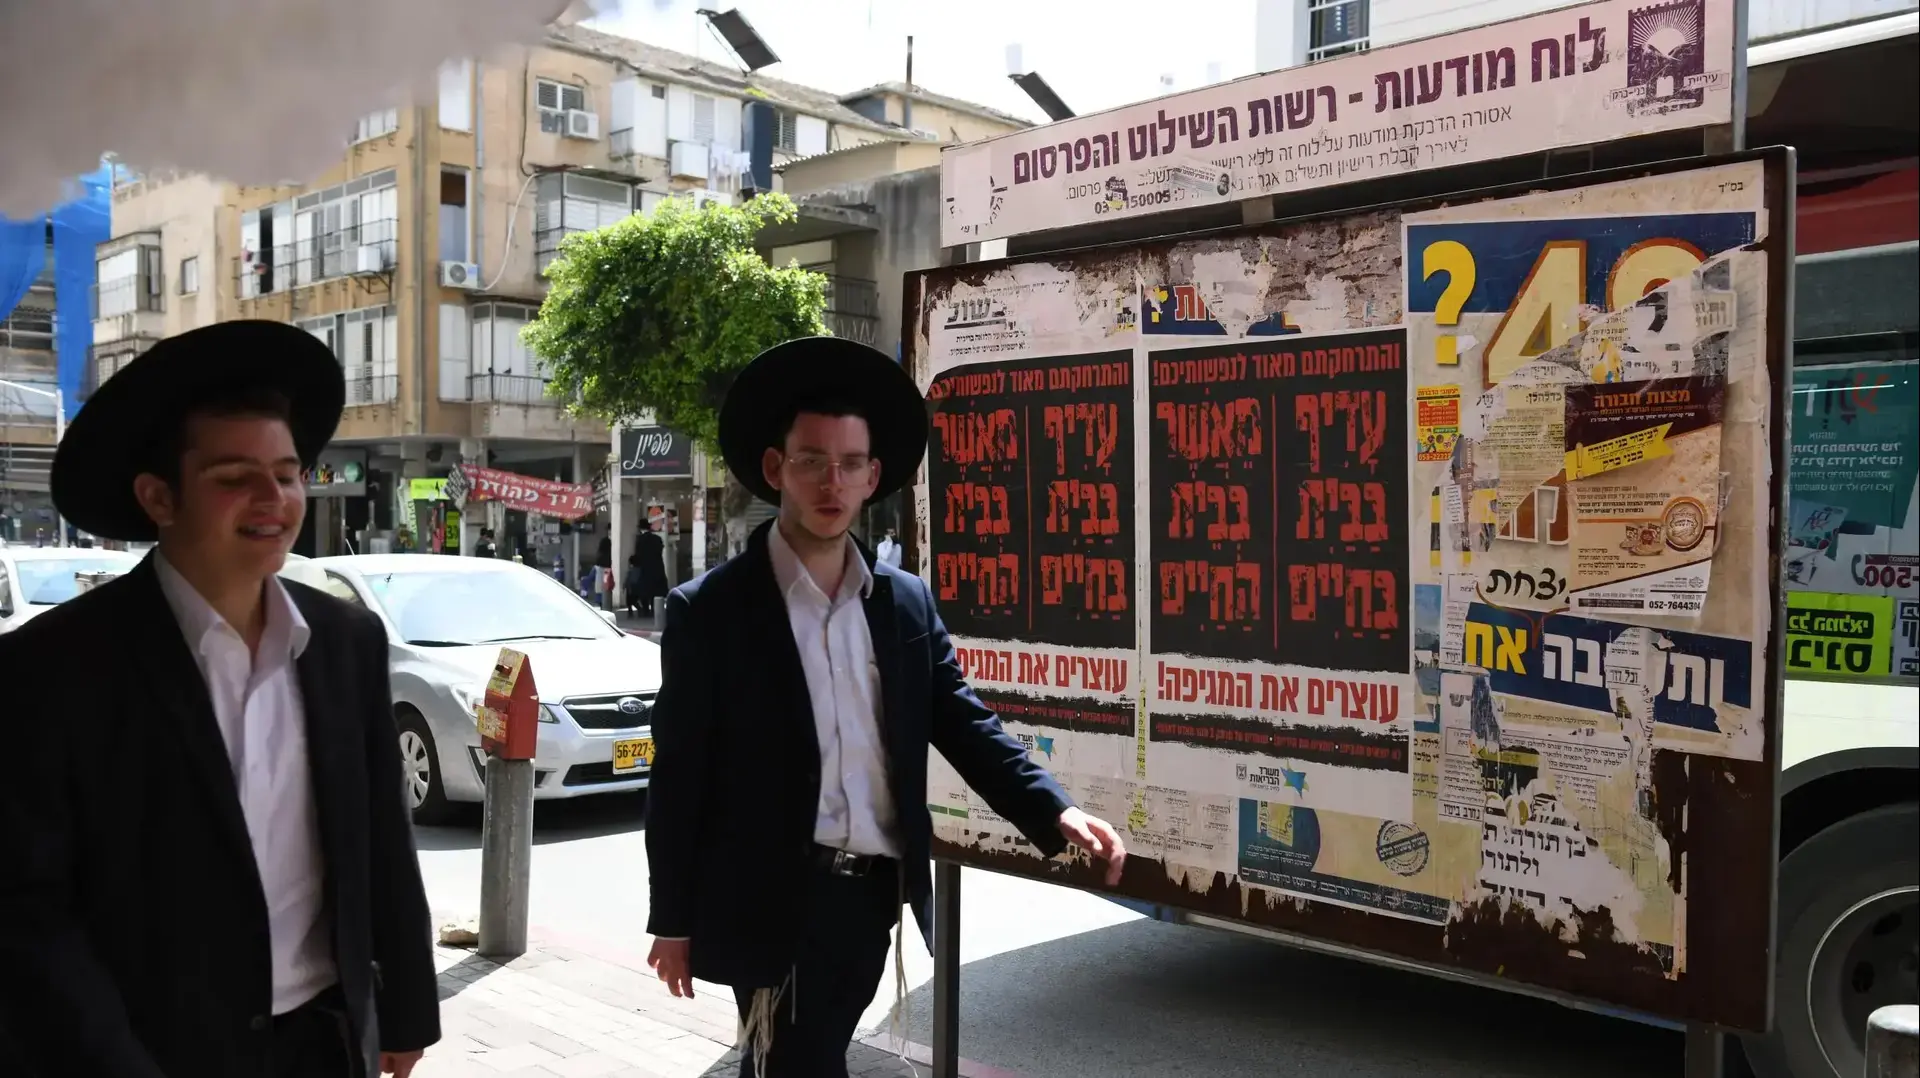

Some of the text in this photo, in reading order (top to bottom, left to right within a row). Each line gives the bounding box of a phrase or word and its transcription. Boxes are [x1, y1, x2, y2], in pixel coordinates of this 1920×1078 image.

[1531, 17, 1607, 83] לוח
[1374, 46, 1516, 113] מודעות
[1687, 73, 1719, 86] עיריית
[1248, 85, 1338, 138] רשות
[1462, 105, 1512, 129] אסורה
[1129, 104, 1239, 161] השילוט
[1348, 125, 1397, 149] מודעות
[1402, 114, 1456, 142] הדבקת
[1279, 145, 1294, 162] זה
[1298, 137, 1321, 159] לוח
[1324, 134, 1344, 152] על
[1013, 130, 1120, 185] והפרסום
[1248, 147, 1275, 168] ללא
[1337, 155, 1374, 178] רישיון
[1380, 146, 1420, 170] קבלת
[1285, 163, 1333, 183] ותשלום
[1049, 362, 1129, 392] והתרחקתם
[1153, 343, 1400, 387] והתרחקתם מאוד לנפשותיכם!
[1009, 369, 1045, 393] מאוד
[1594, 389, 1691, 408] מצות חבורה
[1602, 455, 1621, 472] ברק
[468, 476, 539, 502] מהודרו
[956, 647, 1128, 694] עוצרים את המגיפ
[1543, 633, 1724, 707] ותבה
[1158, 661, 1399, 724] עוצרים את המגיפה!
[1017, 733, 1034, 742] משרד
[1249, 774, 1280, 786] הבריאות
[1259, 766, 1280, 776] משרד
[1480, 850, 1540, 877] ולתור
